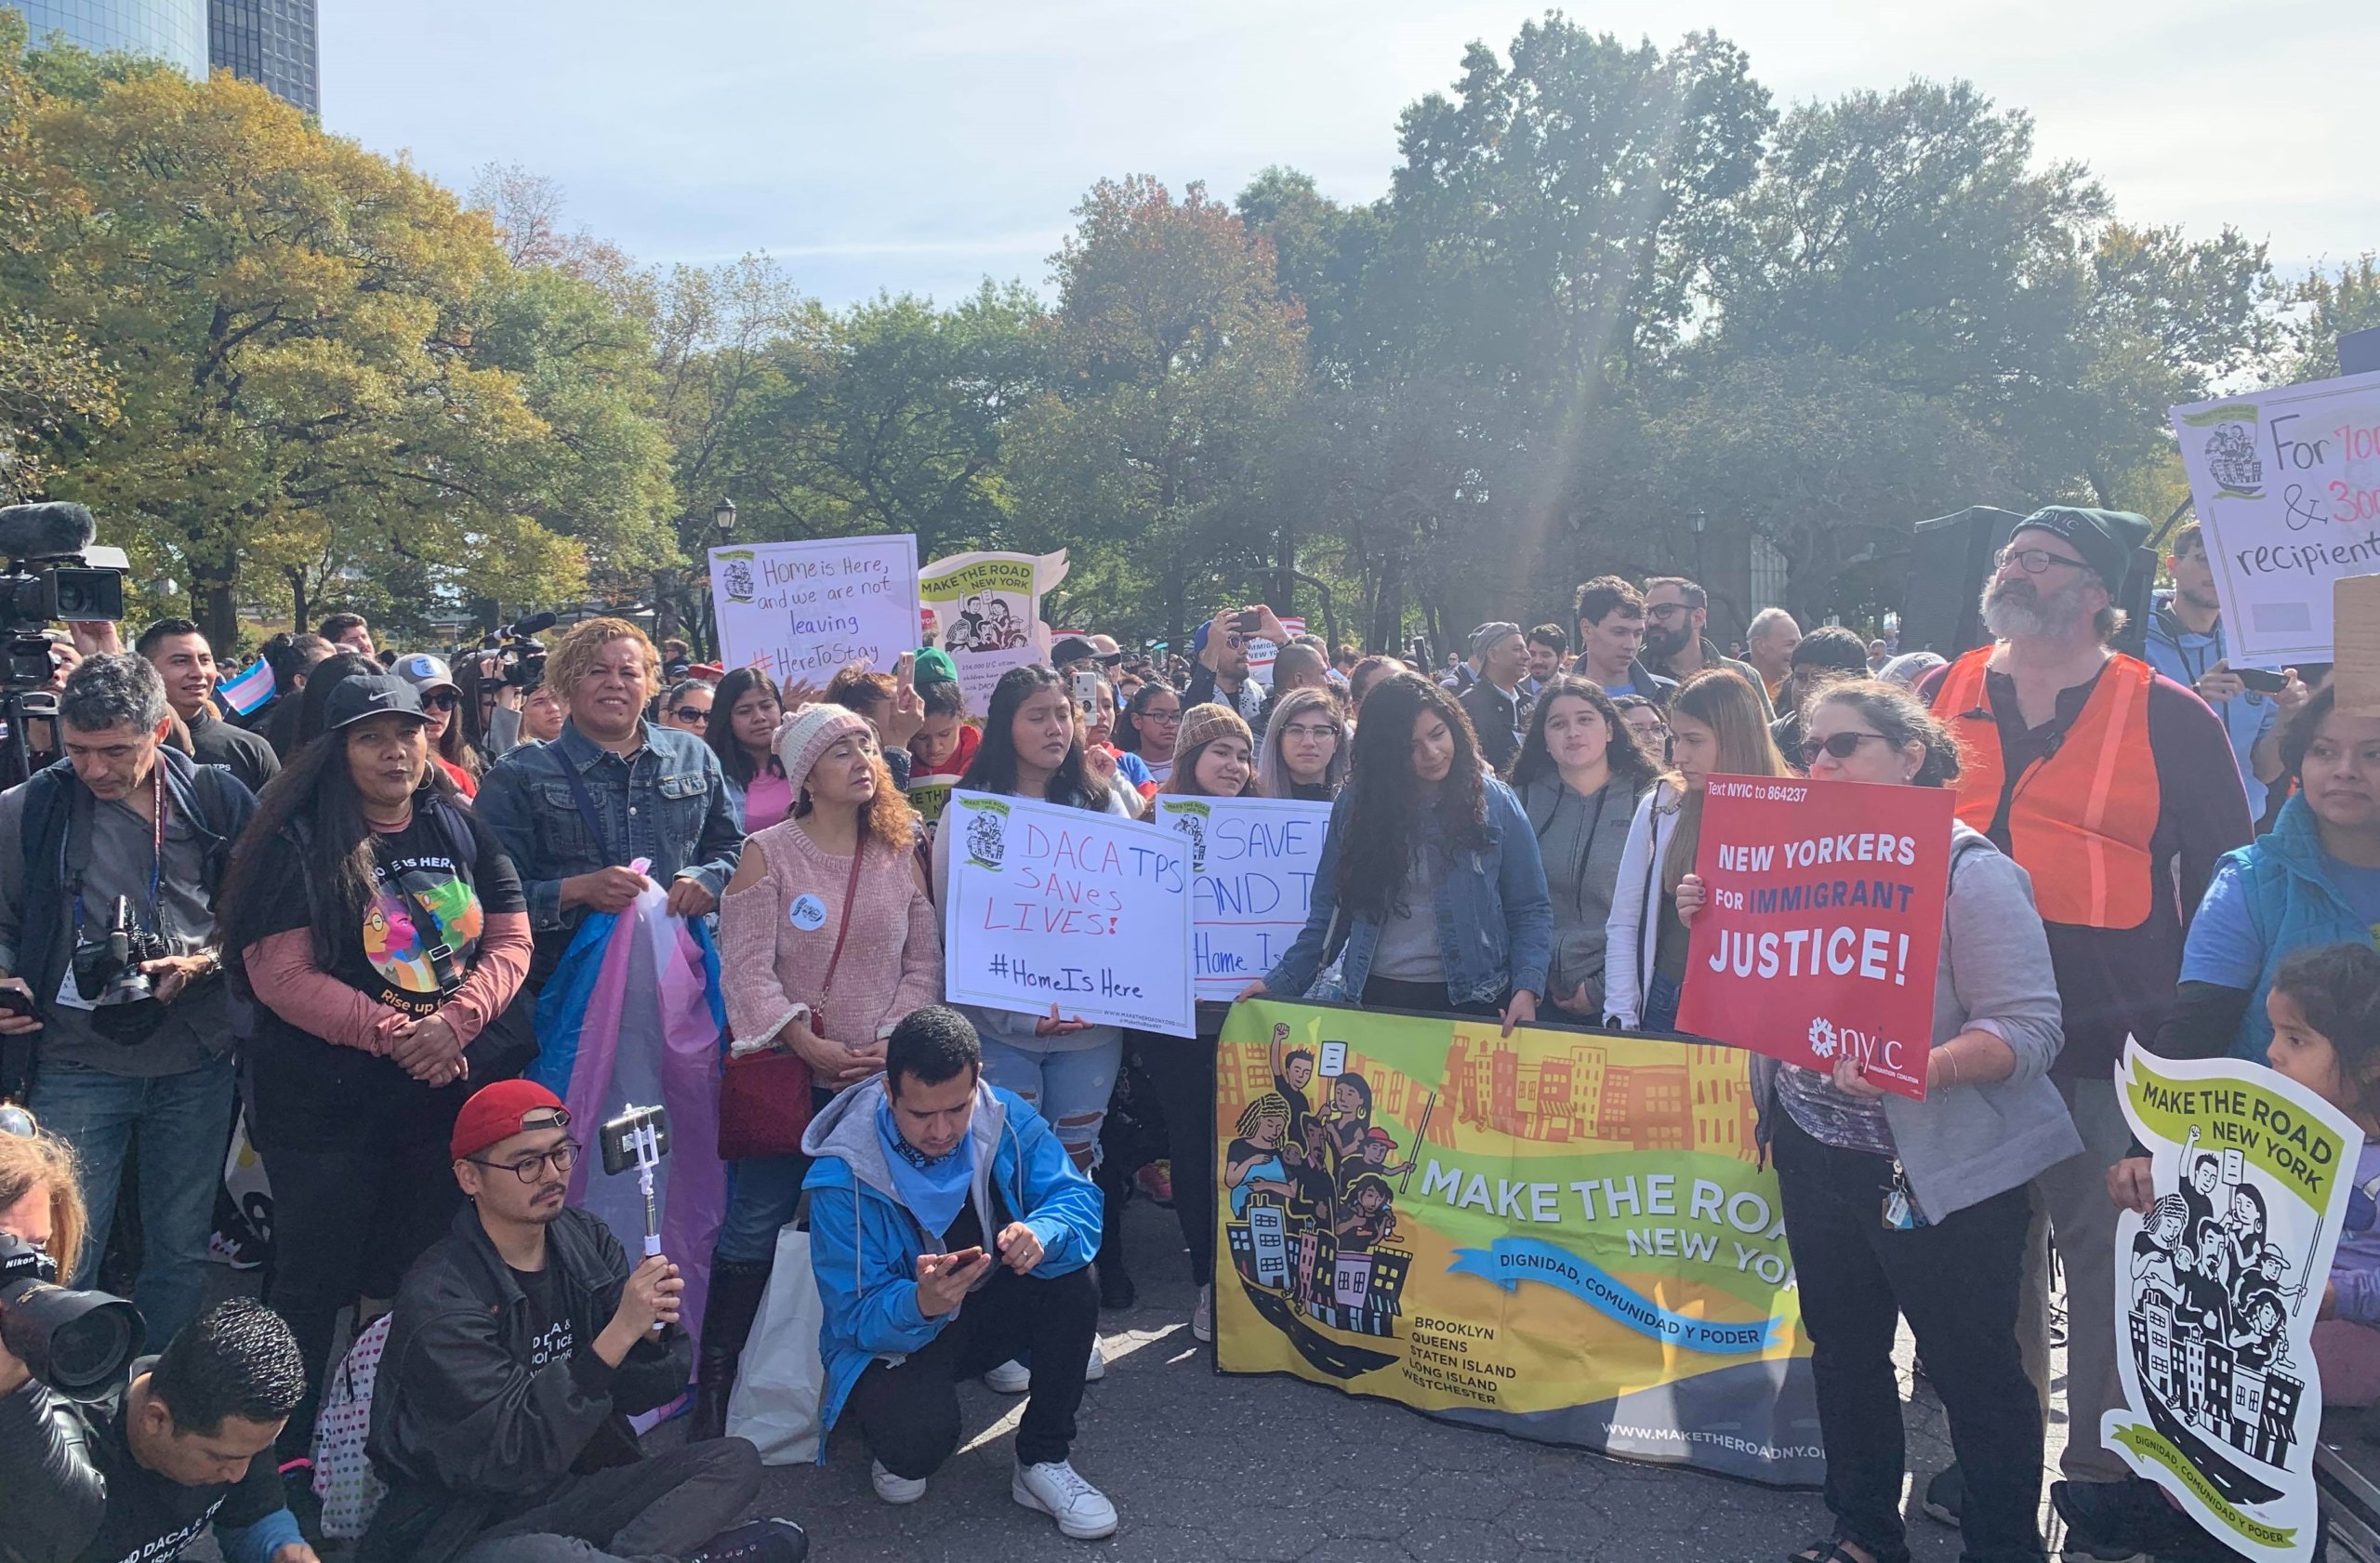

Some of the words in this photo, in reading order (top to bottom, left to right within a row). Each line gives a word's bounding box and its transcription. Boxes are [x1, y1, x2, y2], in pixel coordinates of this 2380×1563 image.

[2270, 414, 2330, 470] For
[2283, 483, 2327, 531] &
[762, 558, 817, 587] Home
[821, 561, 835, 576] is
[843, 556, 889, 575] Here,
[921, 576, 959, 593] MAKE
[959, 565, 987, 582] THE
[990, 564, 1030, 578] ROAD
[971, 578, 997, 590] NEW
[999, 577, 1029, 589] YORK
[759, 589, 787, 610] and
[792, 591, 817, 604] we
[827, 585, 854, 601] are
[861, 576, 892, 595] not
[789, 609, 859, 635] leaving
[745, 642, 879, 679] #HereToStay
[978, 682, 995, 691] DACA
[1708, 782, 1726, 797] Text
[1727, 783, 1752, 798] NYIC
[1755, 785, 1765, 800] to
[1767, 786, 1807, 802] 864237
[1216, 818, 1311, 860] SAVE
[1719, 843, 1775, 872] NEW
[1784, 833, 1916, 869] YORKERS
[420, 857, 451, 868] HER
[1020, 824, 1123, 876] DACA
[1129, 847, 1183, 893] TPS
[1194, 872, 1280, 916] AND
[1715, 888, 1743, 911] FOR
[1749, 880, 1915, 914] IMMIGRANT
[984, 897, 1117, 935] LIVES!
[1195, 932, 1248, 974] Home
[1709, 926, 1910, 987] JUSTICE!
[381, 988, 410, 1010] Rise
[415, 1001, 434, 1013] up
[1840, 1026, 1902, 1074] nyic
[2142, 1081, 2196, 1115] MAKE
[2201, 1090, 2247, 1116] THE
[2252, 1098, 2333, 1165] ROAD
[2213, 1120, 2260, 1148] NEW
[2266, 1136, 2324, 1194] YORK
[1421, 1159, 1561, 1223] MAKE
[1570, 1174, 1676, 1221] THE
[6, 1256, 35, 1269] Nikon
[1625, 1227, 1718, 1264] NEW
[1500, 1253, 1580, 1286] DIGNIDAD,
[1585, 1278, 1680, 1335] COMUNIDAD
[1684, 1326, 1696, 1340] Y
[1700, 1328, 1760, 1344] PODER
[1411, 1332, 1468, 1353] QUEENS
[1415, 1317, 1495, 1341] BROOKLYN
[1409, 1358, 1443, 1380] LONG
[1446, 1371, 1498, 1393] ISLAND
[1410, 1344, 1460, 1368] STATEN
[1462, 1357, 1517, 1380] ISLAND
[1402, 1369, 1496, 1405] WESTCHESTER
[1602, 1422, 1826, 1460] WWW.MAKETHEROADNY.O
[2181, 1465, 2236, 1522] COMUNIDAD
[2239, 1518, 2246, 1528] Y
[2248, 1524, 2284, 1543] PODER
[143, 1527, 189, 1557] DACA
